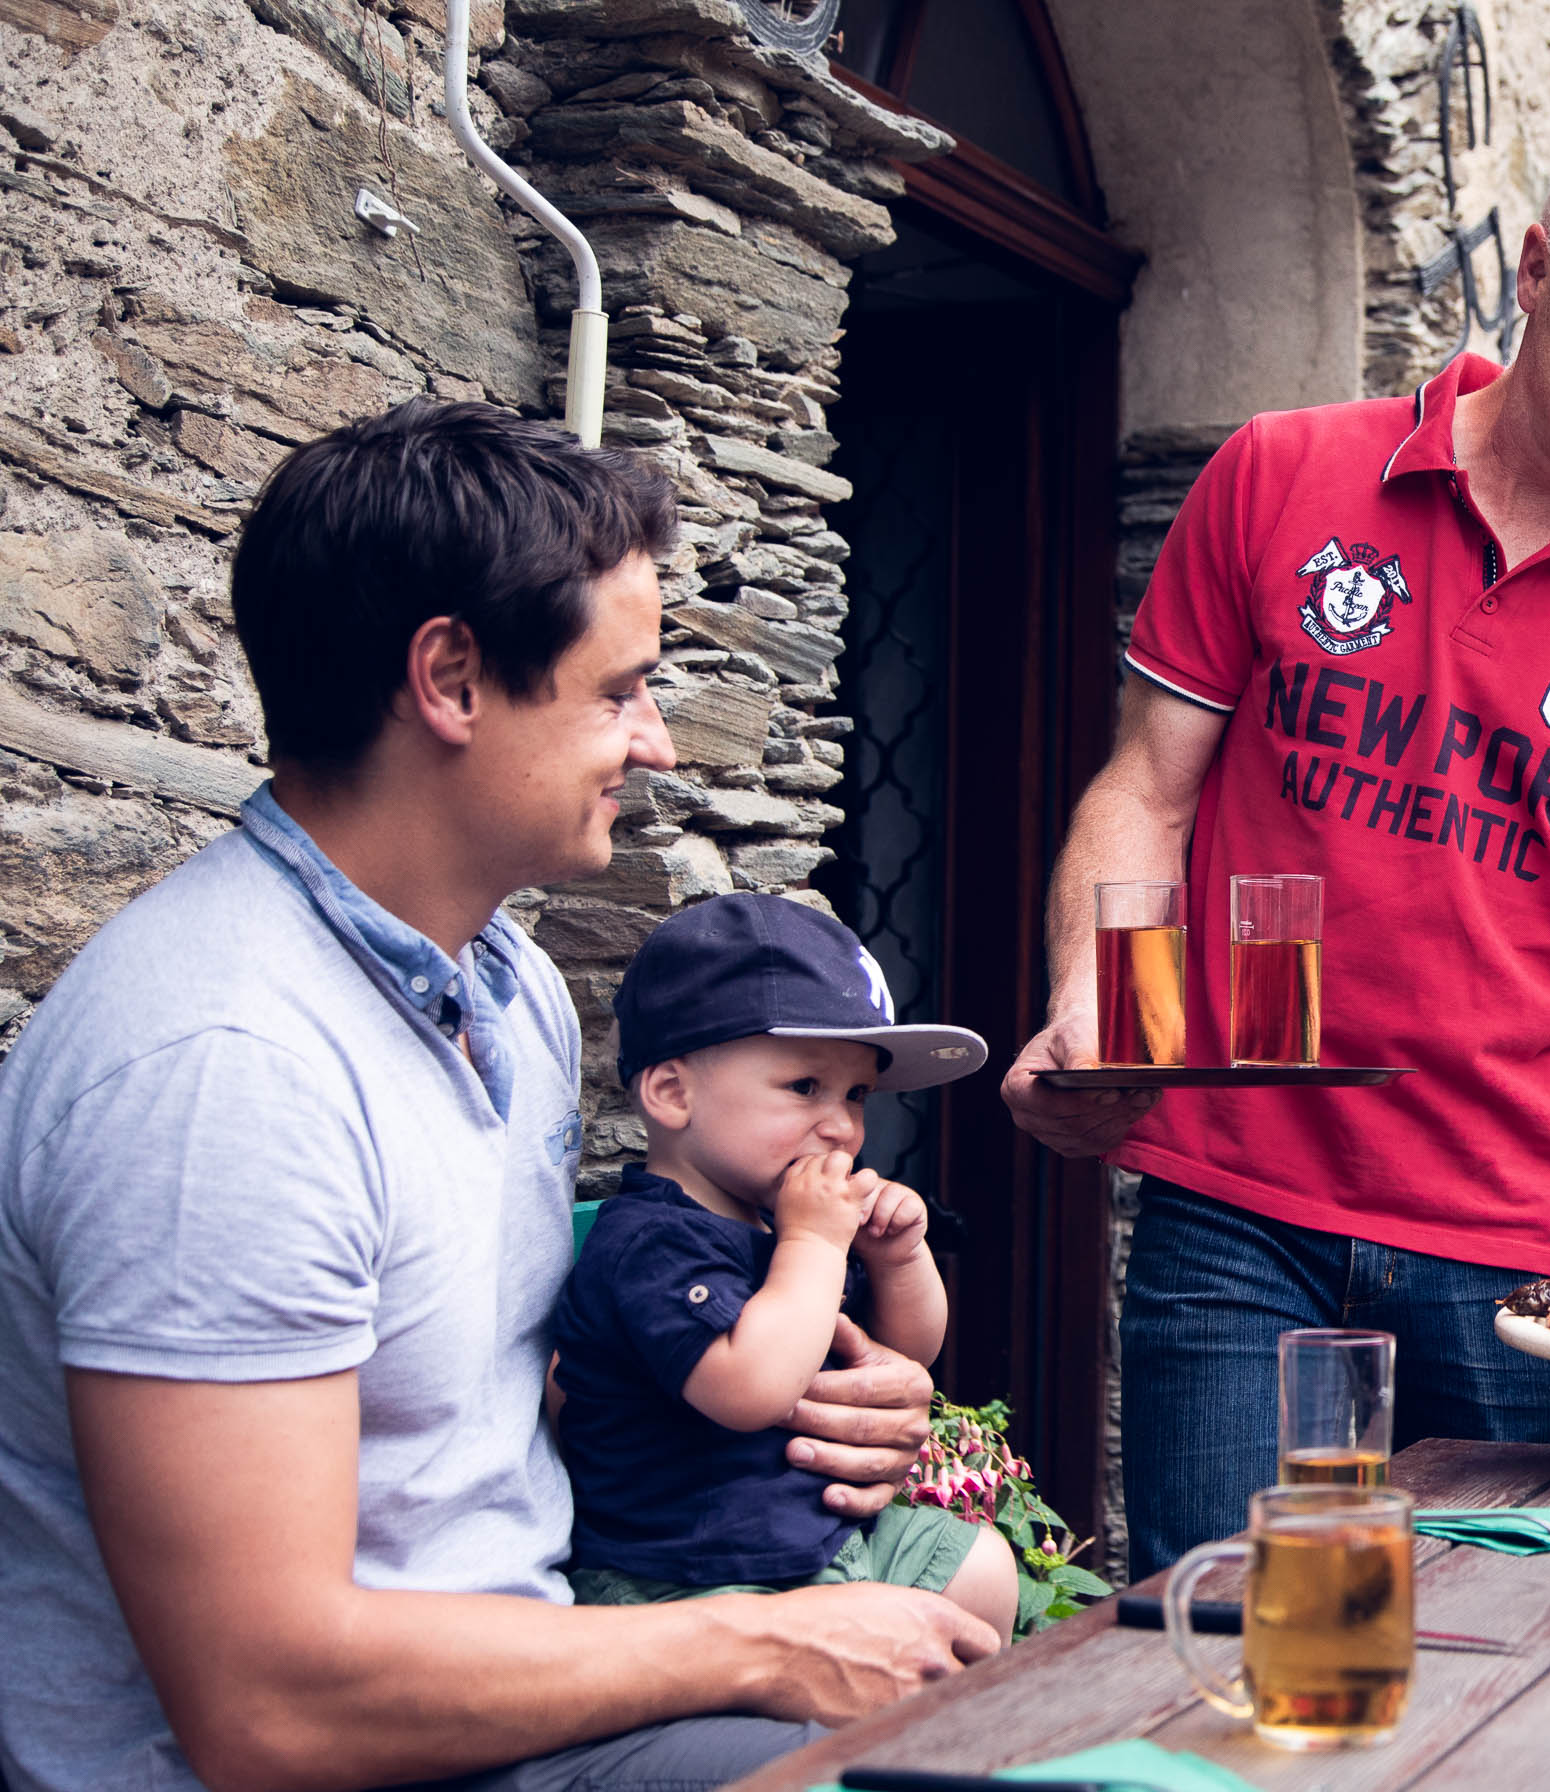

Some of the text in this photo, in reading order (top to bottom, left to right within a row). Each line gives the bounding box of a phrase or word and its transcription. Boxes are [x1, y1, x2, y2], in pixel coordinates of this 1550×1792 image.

[1313, 551, 1339, 568] EST.
[1304, 620, 1377, 653] AUTHENTIC GARMENT
[1264, 656, 1426, 767] NEW
[1282, 751, 1546, 882] AUTHENTIC
